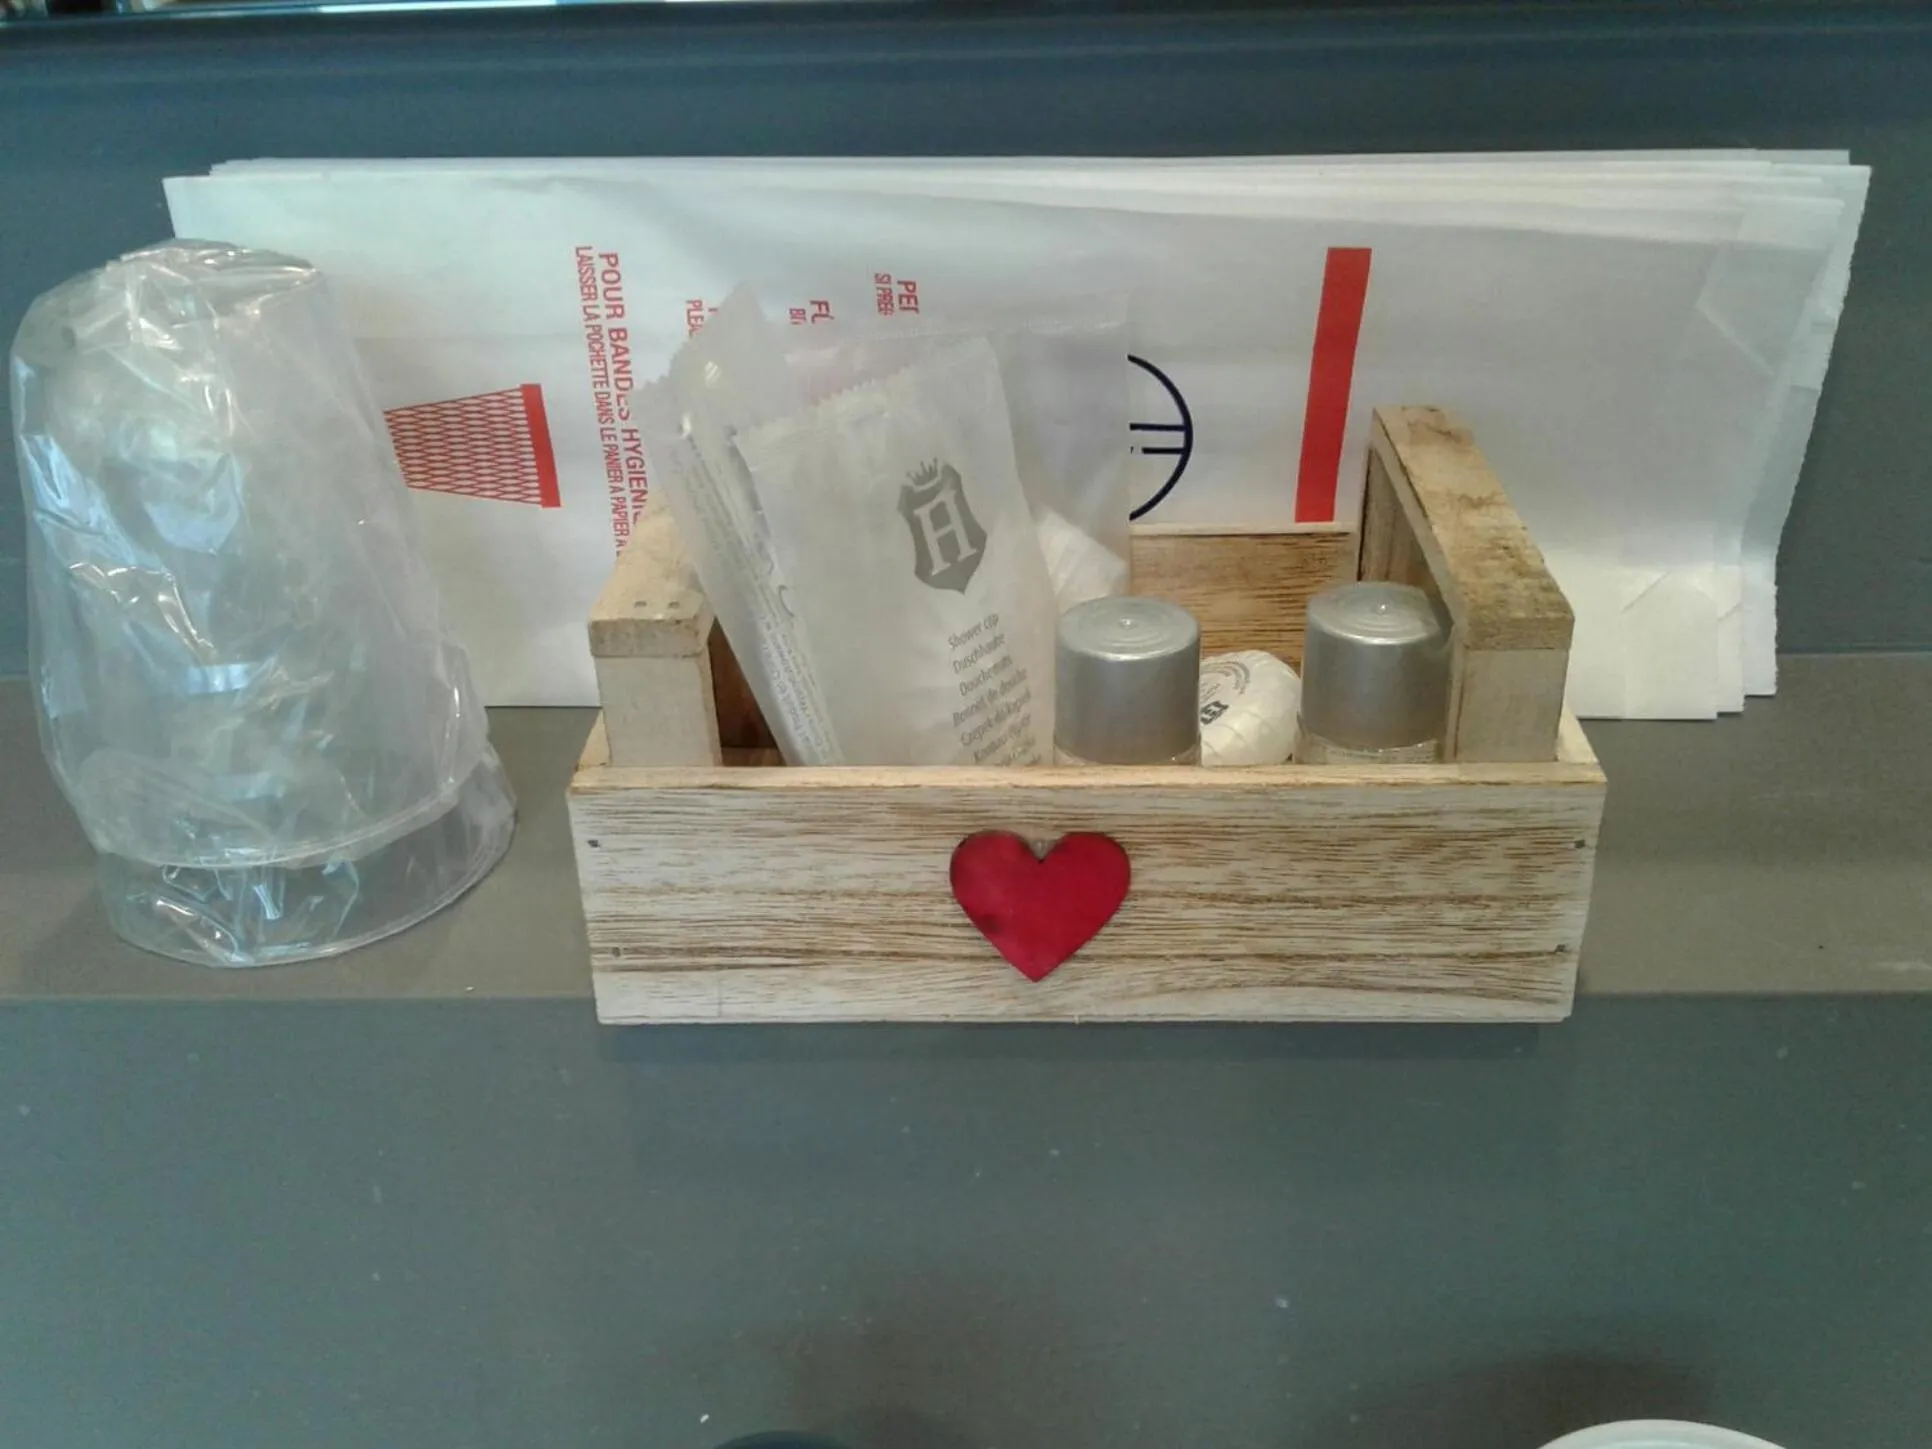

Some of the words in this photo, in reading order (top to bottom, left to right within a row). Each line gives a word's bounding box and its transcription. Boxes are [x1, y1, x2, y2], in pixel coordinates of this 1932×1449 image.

[575, 246, 598, 301] LAISSER
[599, 252, 626, 320] POUR
[582, 304, 601, 322] LA
[585, 324, 609, 389] POCHETTE
[594, 391, 615, 424] DANS
[600, 427, 617, 442] LE
[602, 444, 624, 483] PANIER
[610, 497, 630, 537] PAPIER
